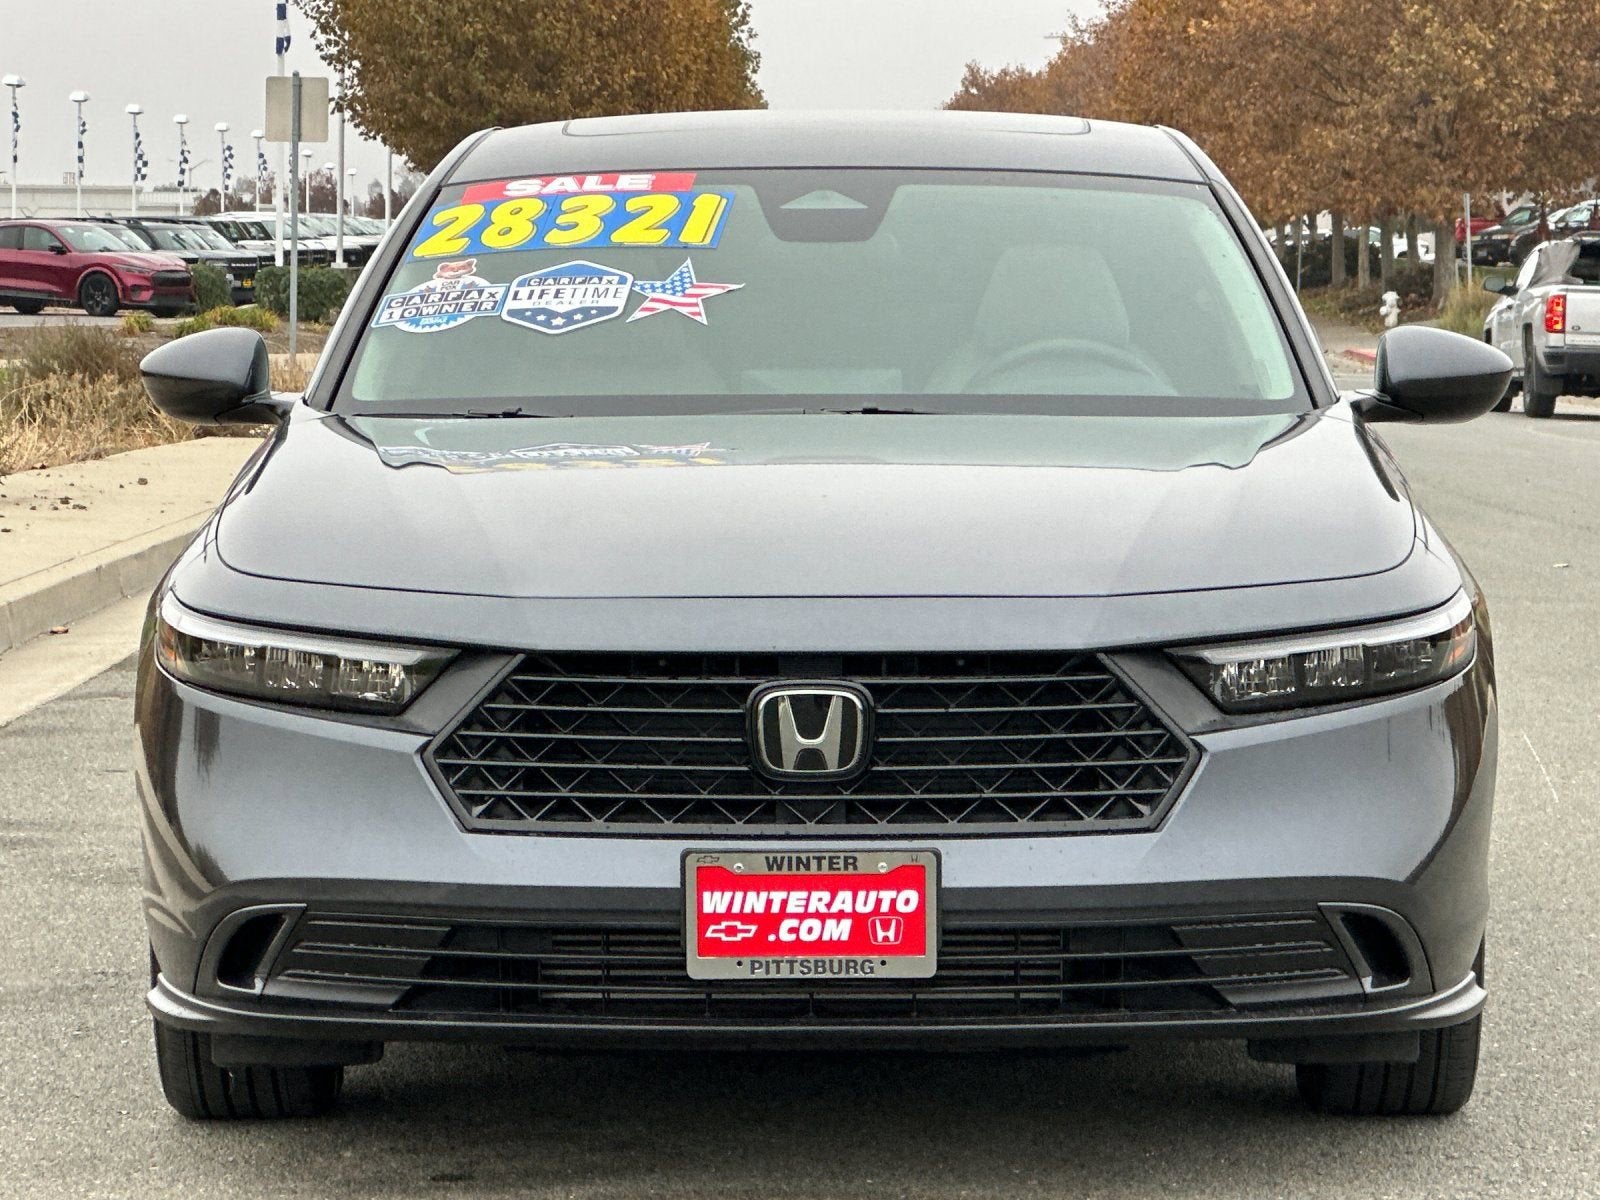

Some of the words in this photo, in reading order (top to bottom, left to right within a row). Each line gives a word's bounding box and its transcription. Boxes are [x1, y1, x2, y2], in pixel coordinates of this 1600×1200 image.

[503, 173, 655, 196] SALE
[412, 193, 728, 258] 28321
[527, 276, 616, 287] CARFAX
[388, 289, 500, 309] CARFAX
[511, 286, 626, 301] LIFETIME
[532, 299, 600, 307] DEALER
[386, 310, 396, 320] 1
[402, 300, 495, 318] OWNER
[764, 855, 859, 872] WINTER
[702, 889, 920, 914] WINTERAUTO
[767, 918, 853, 942] .COM
[750, 959, 876, 976] PITTSBURG
